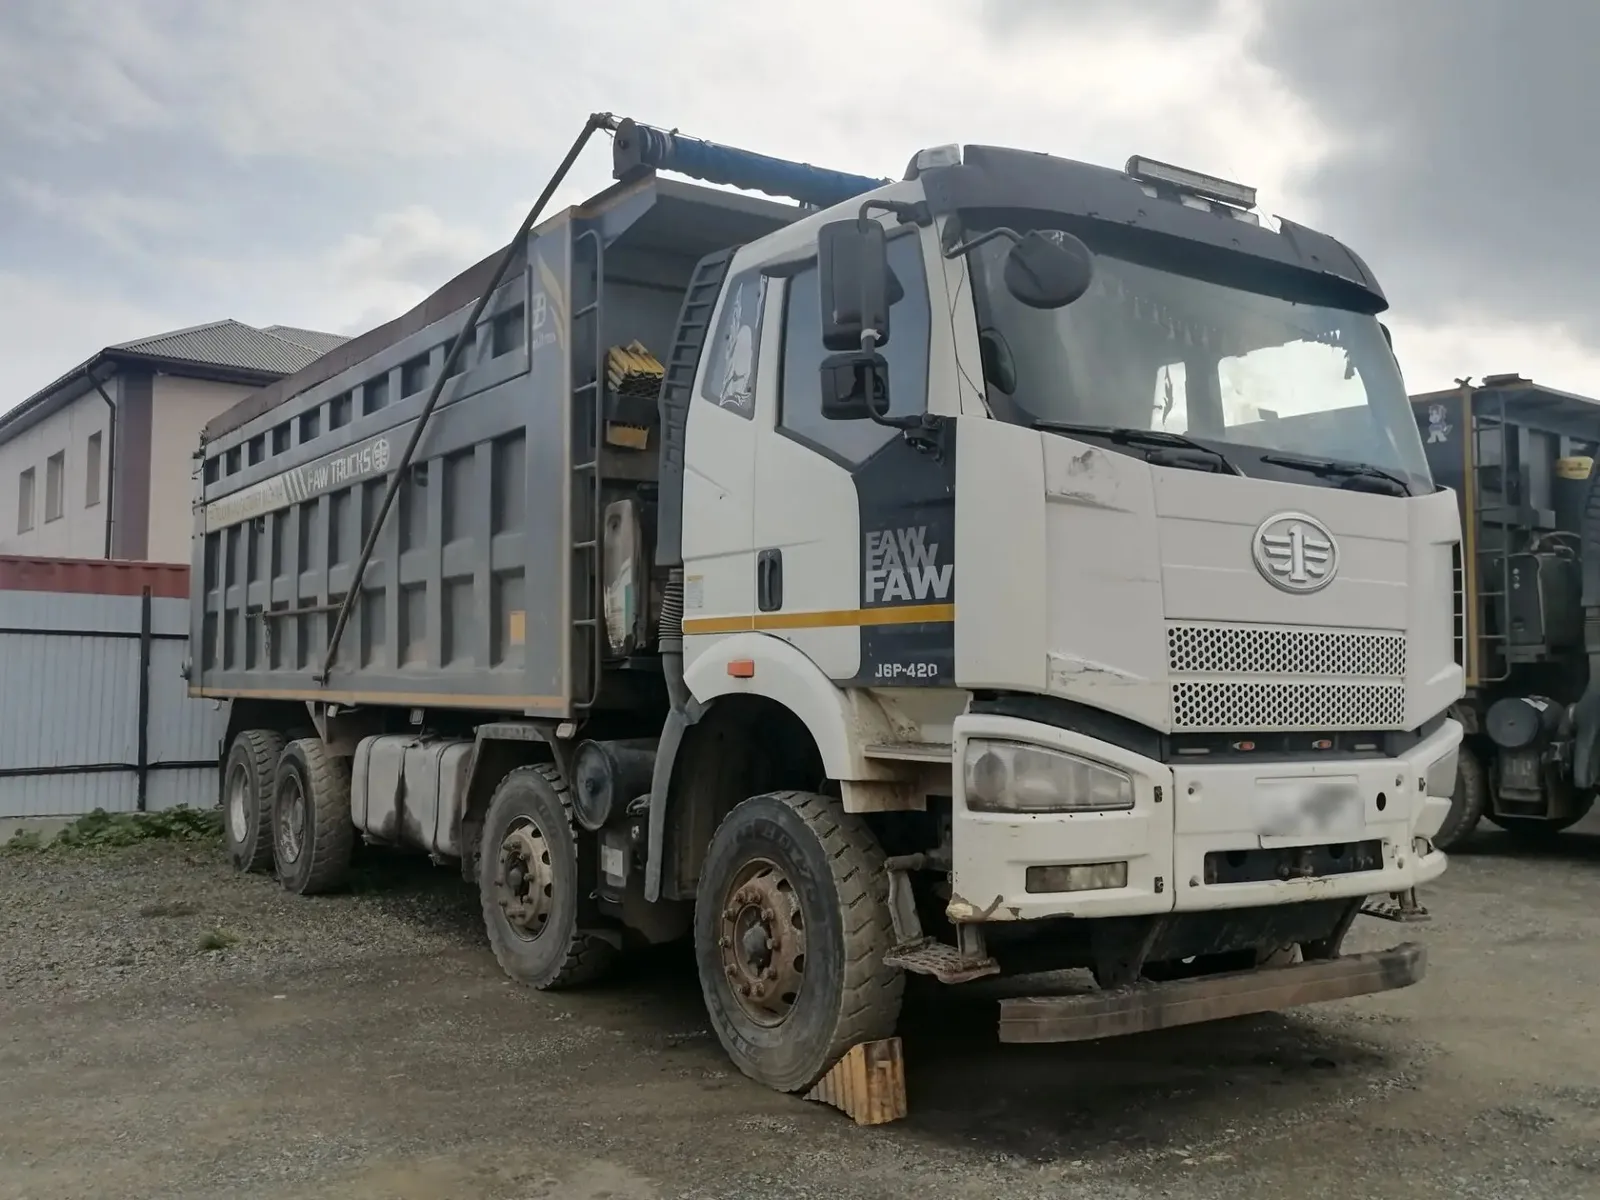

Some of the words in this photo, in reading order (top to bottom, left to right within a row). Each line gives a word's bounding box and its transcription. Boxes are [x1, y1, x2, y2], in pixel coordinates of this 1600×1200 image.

[331, 447, 371, 485] TRUCKS
[865, 563, 954, 603] FAW
[874, 662, 938, 678] J6P-420
